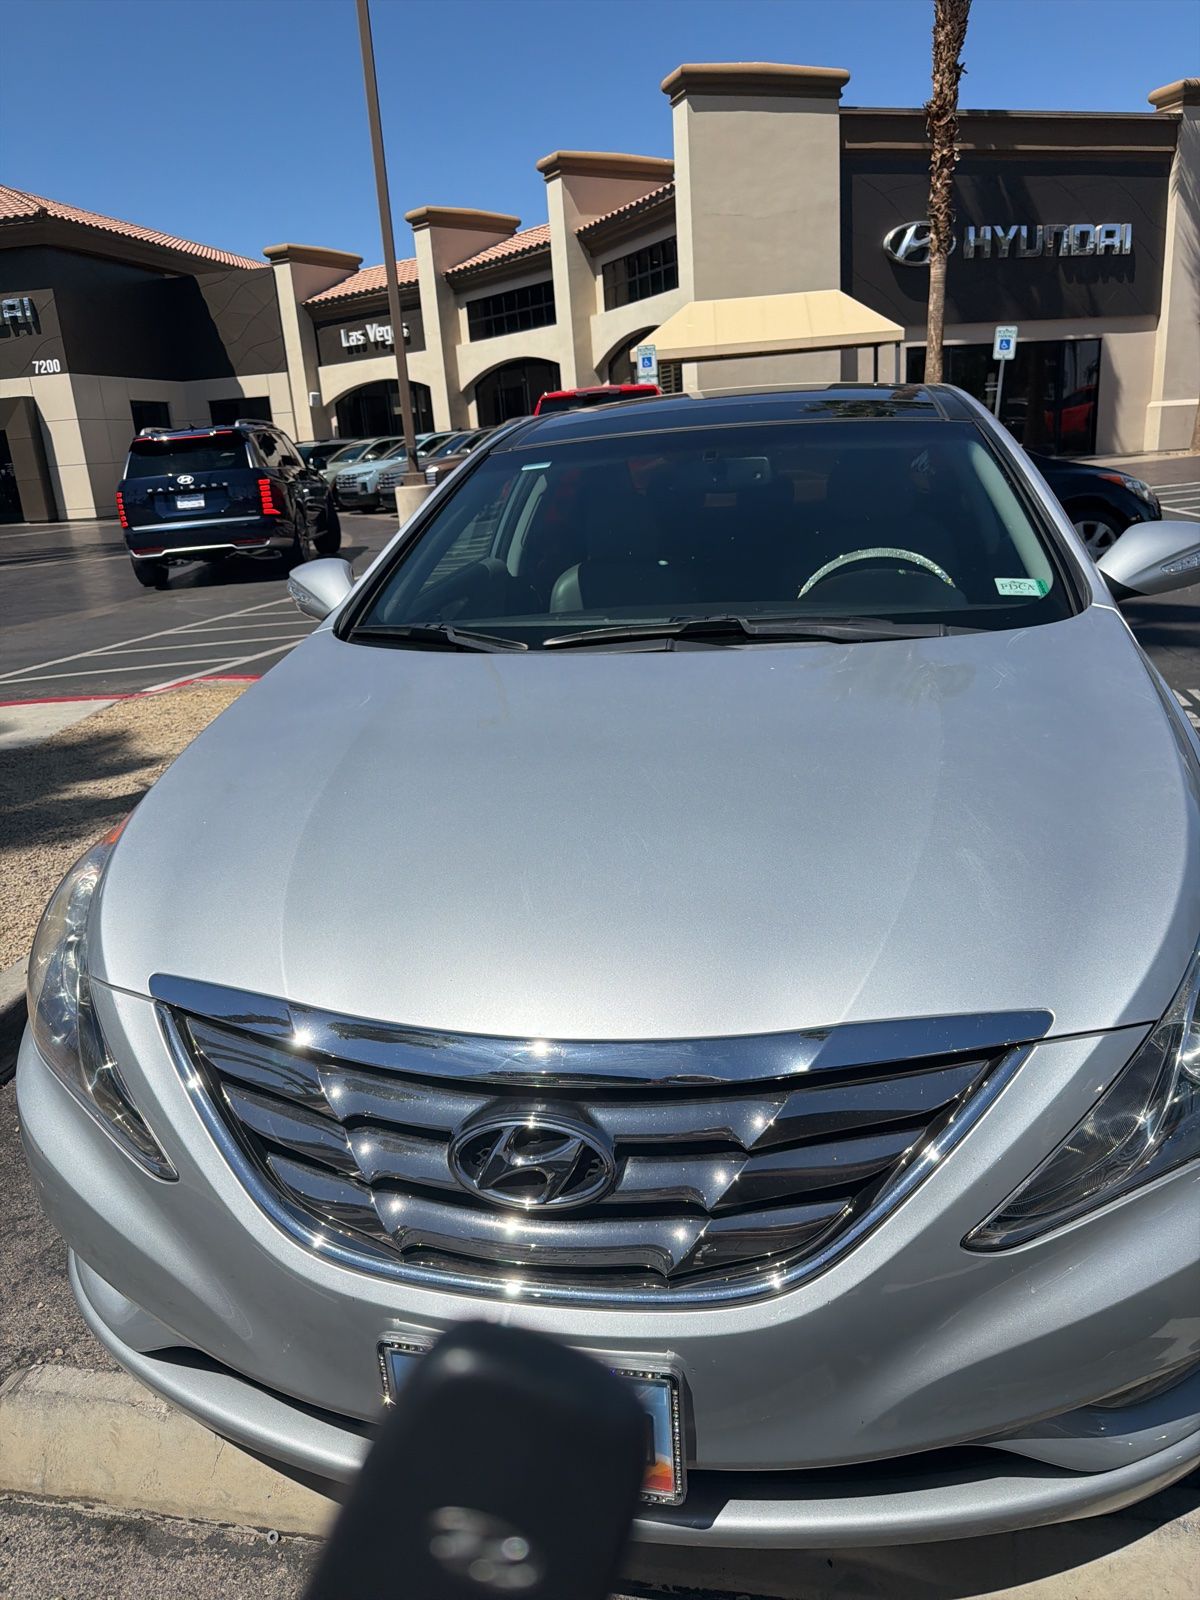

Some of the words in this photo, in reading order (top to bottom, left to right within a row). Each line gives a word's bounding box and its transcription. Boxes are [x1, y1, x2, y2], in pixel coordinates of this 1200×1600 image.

[963, 223, 1133, 259] HYUNDAI
[0, 297, 33, 325] AI
[340, 329, 366, 347] Las
[365, 323, 410, 345] Vegs
[32, 359, 61, 374] 7200
[147, 482, 228, 492] PALISADE
